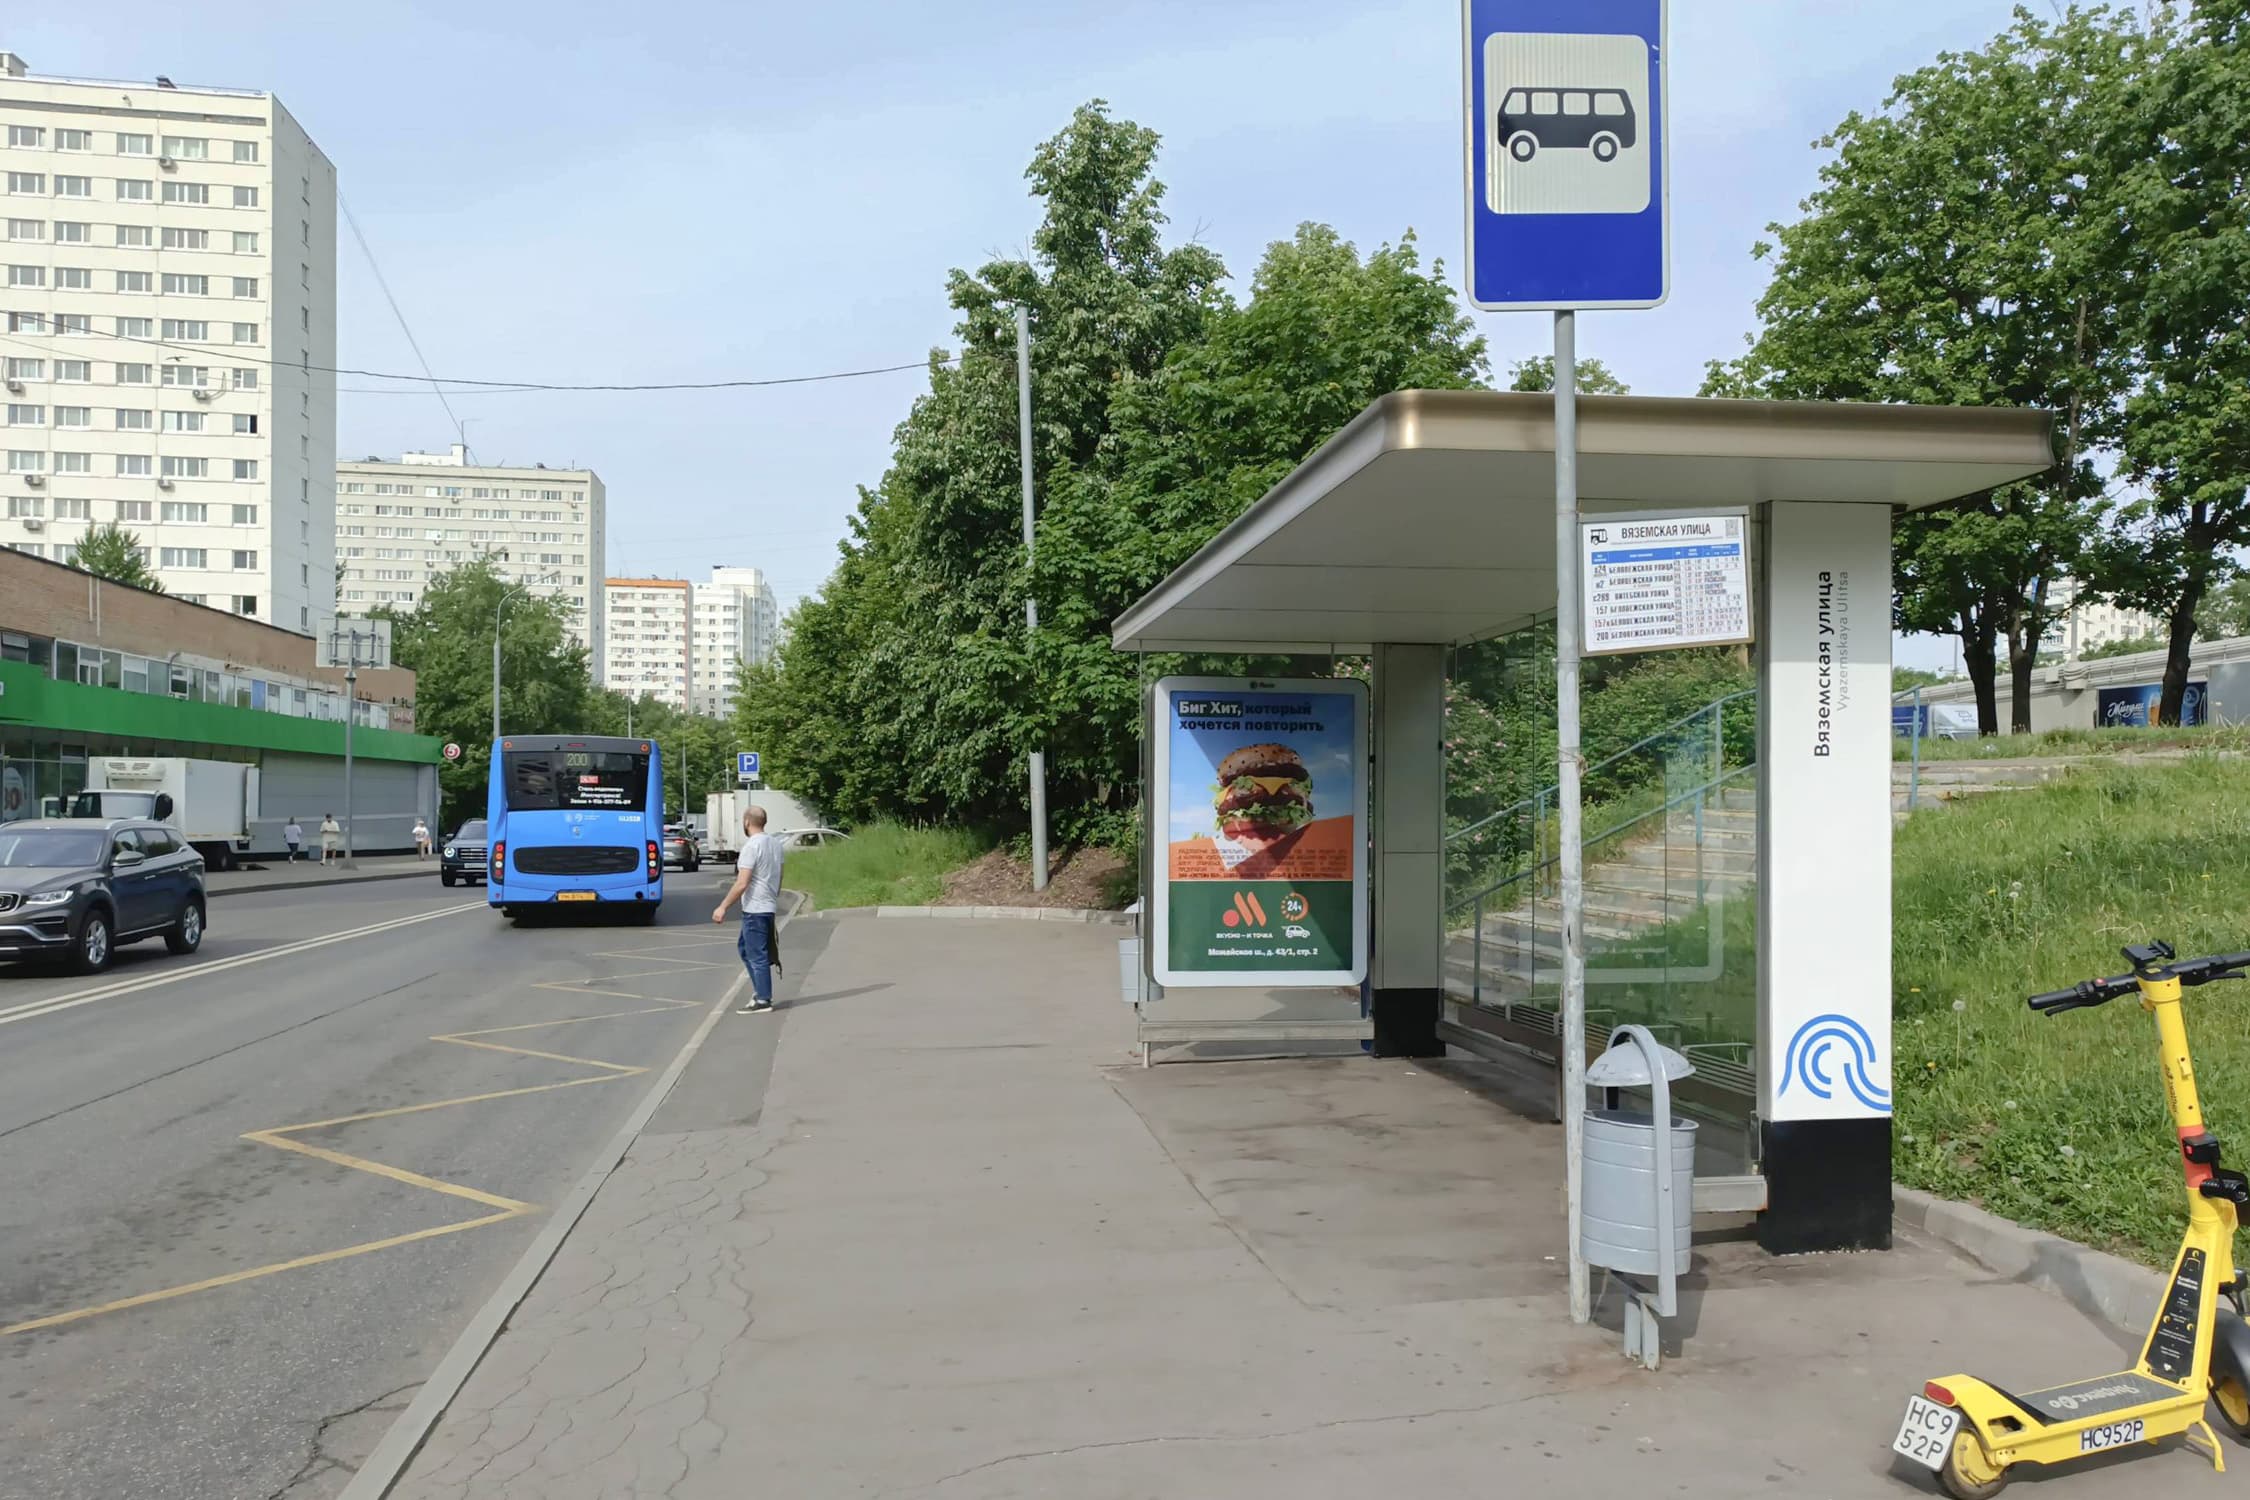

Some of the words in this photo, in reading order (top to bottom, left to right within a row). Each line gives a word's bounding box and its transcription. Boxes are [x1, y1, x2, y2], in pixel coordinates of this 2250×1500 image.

[1621, 525, 1678, 539] ВЯЗЕМСКАЯ
[1681, 522, 1711, 536] УЛИЦА
[1836, 571, 1849, 613] Ulitsa
[1596, 606, 1608, 615] 157
[1818, 571, 1835, 635] улица
[1596, 631, 1609, 641] 200
[1836, 617, 1850, 711] Vyazemskaya
[1814, 642, 1832, 757] Вяземская
[1179, 701, 1207, 714] Биг
[1210, 701, 1242, 716] Хит,
[1245, 702, 1312, 717] который
[1178, 720, 1241, 731] хочется
[1245, 721, 1324, 733] повторить
[567, 753, 588, 767] 200
[743, 755, 755, 770] P
[1312, 947, 1318, 956] 2
